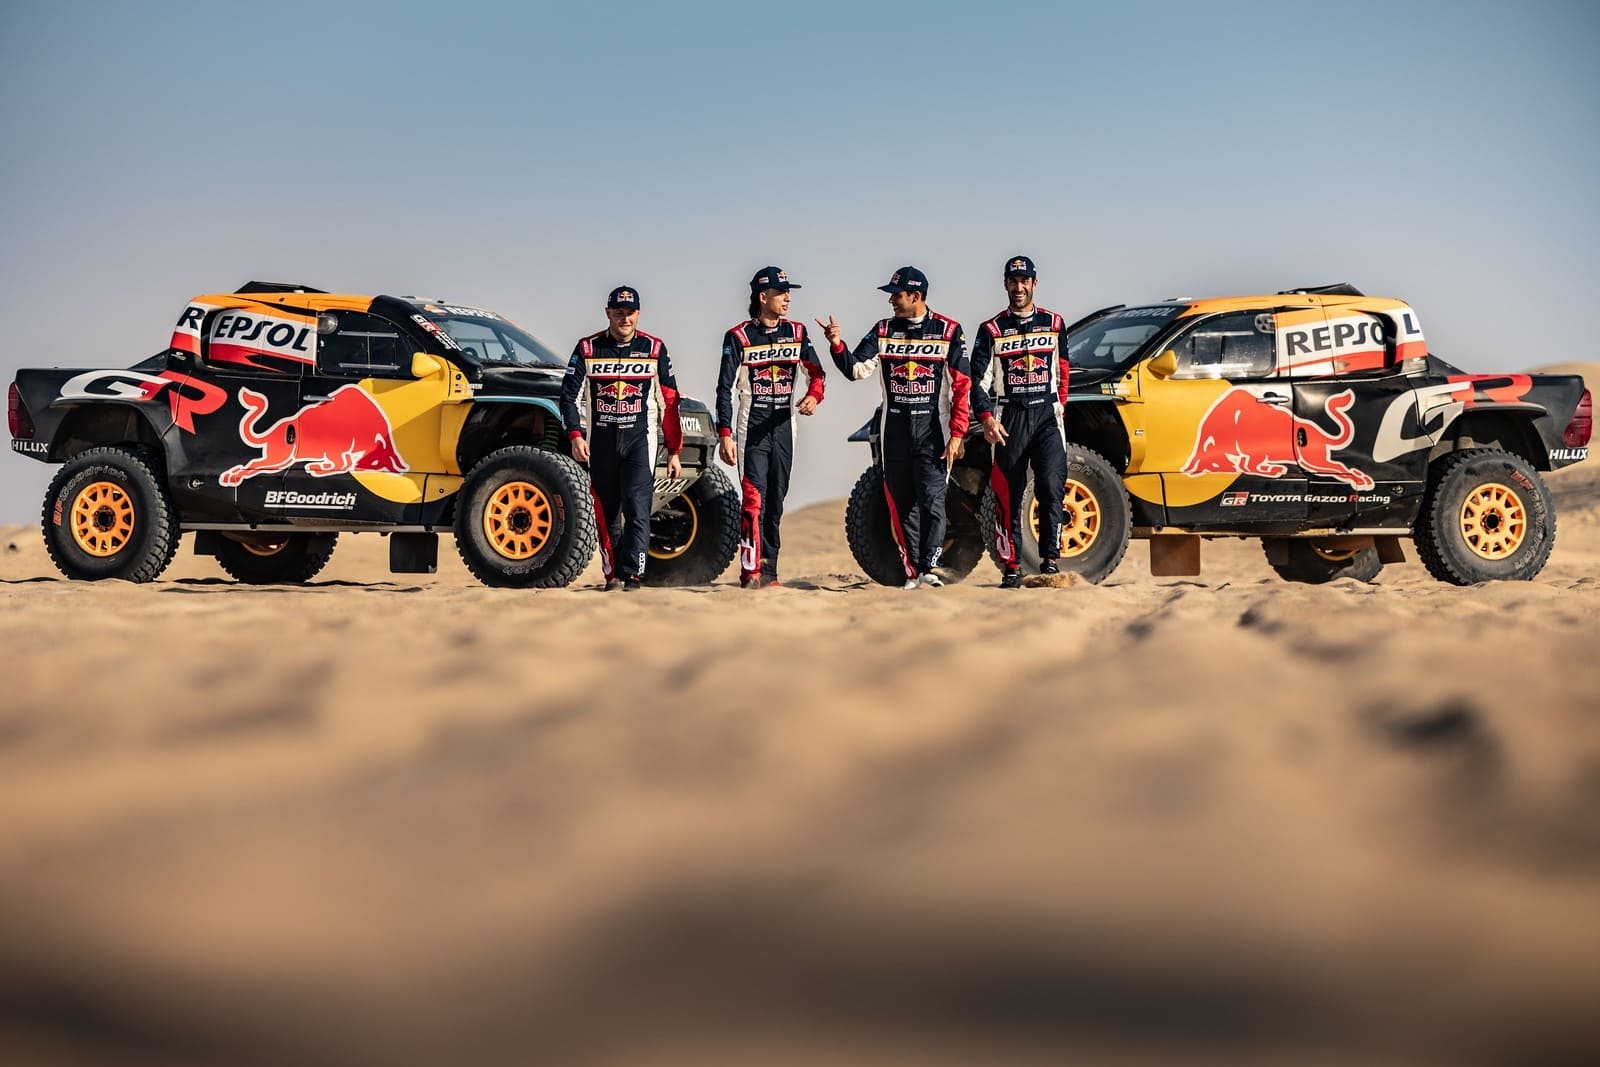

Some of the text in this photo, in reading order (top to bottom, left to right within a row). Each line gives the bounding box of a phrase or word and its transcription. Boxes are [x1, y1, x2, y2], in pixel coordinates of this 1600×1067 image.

[885, 343, 941, 355] REPSOL
[1001, 337, 1053, 352] REPSOL
[749, 347, 798, 361] REPSOL
[592, 363, 651, 375] REPSOL
[1008, 371, 1049, 384] Red Bull
[753, 382, 793, 395] Red Bull
[890, 380, 935, 394] Red Bull
[596, 398, 642, 414] Red Bull
[680, 417, 702, 432] YOTA
[11, 440, 48, 453] HILUX
[1549, 449, 1588, 460] HILUX
[264, 490, 357, 506] BFGoodrich
[1221, 495, 1248, 506] GR
[1250, 494, 1301, 503] TOYOTA
[1348, 494, 1391, 504] Racing
